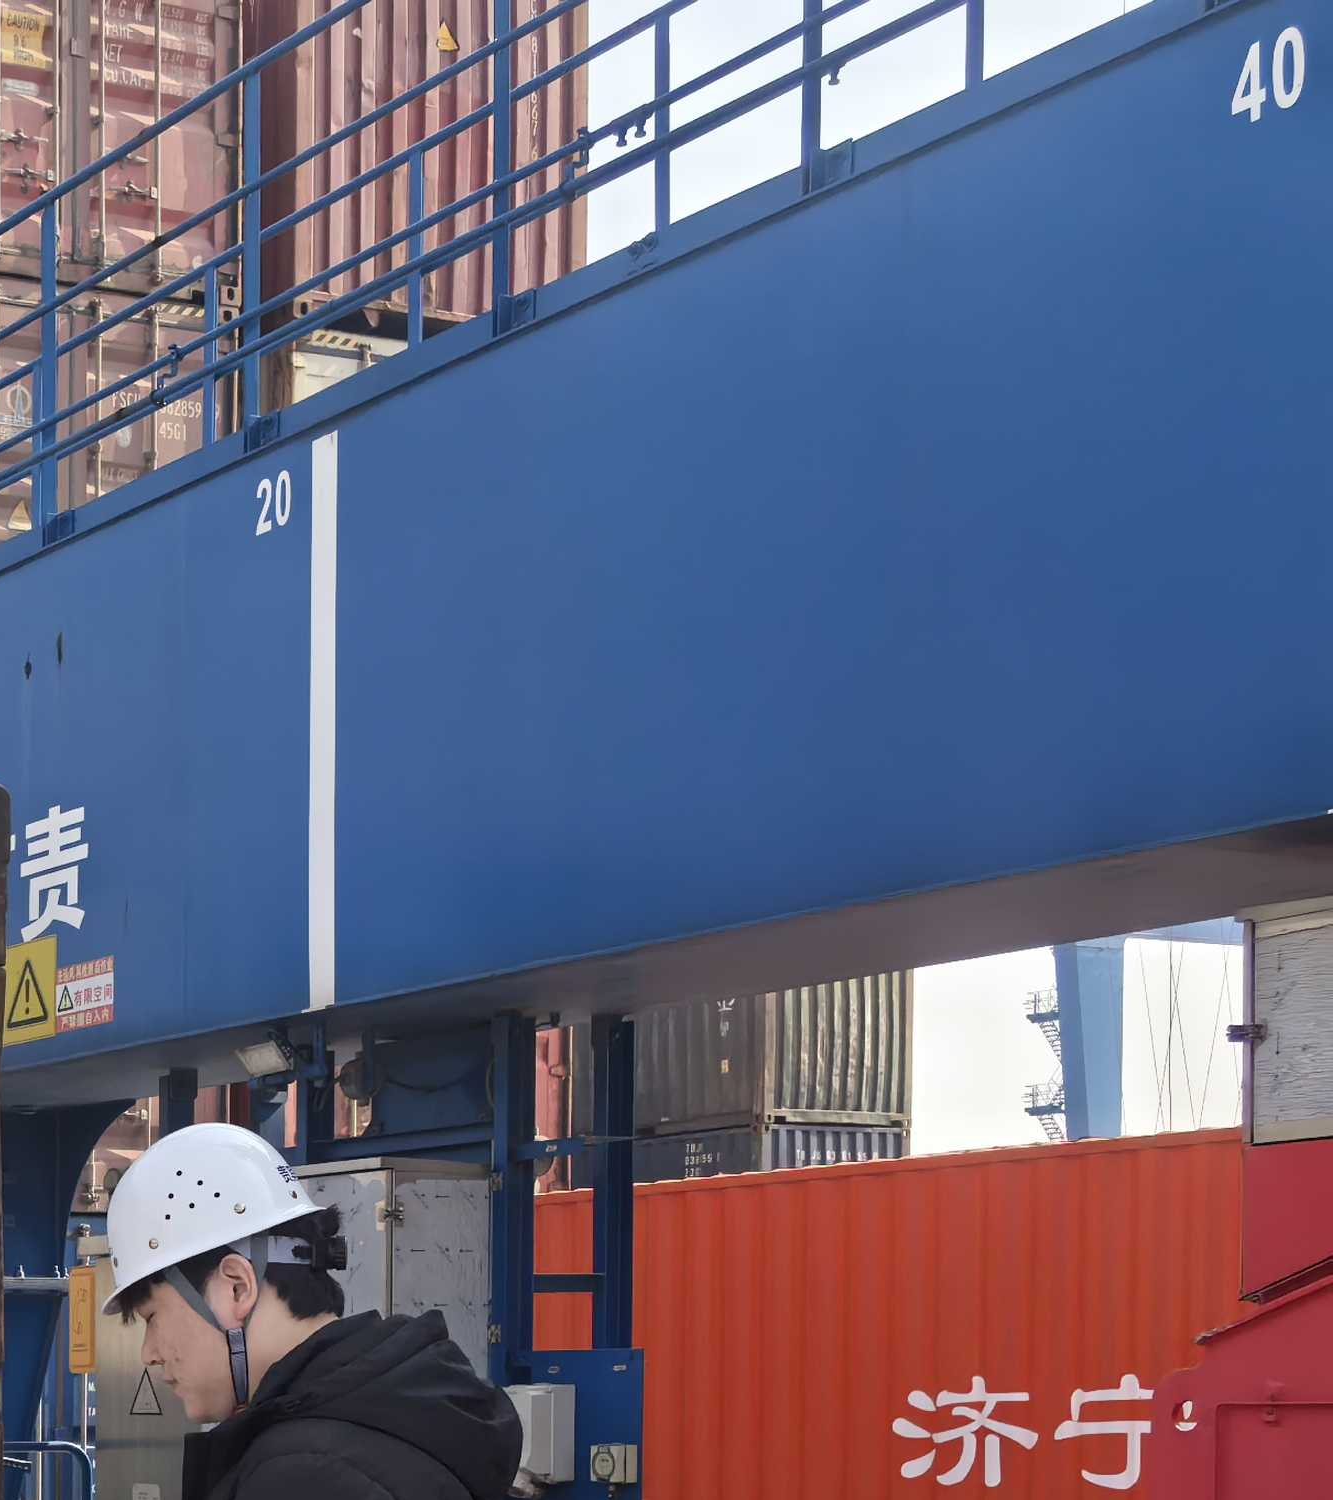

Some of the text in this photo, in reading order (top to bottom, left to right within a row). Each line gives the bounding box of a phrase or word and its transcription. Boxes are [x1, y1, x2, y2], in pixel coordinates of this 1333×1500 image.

[1232, 26, 1305, 123] 40
[159, 421, 187, 441] 45G1
[256, 470, 291, 536] 20
[10, 805, 89, 943] 责
[74, 983, 113, 1008] 有限空间
[892, 1374, 1198, 1490] 济宁
